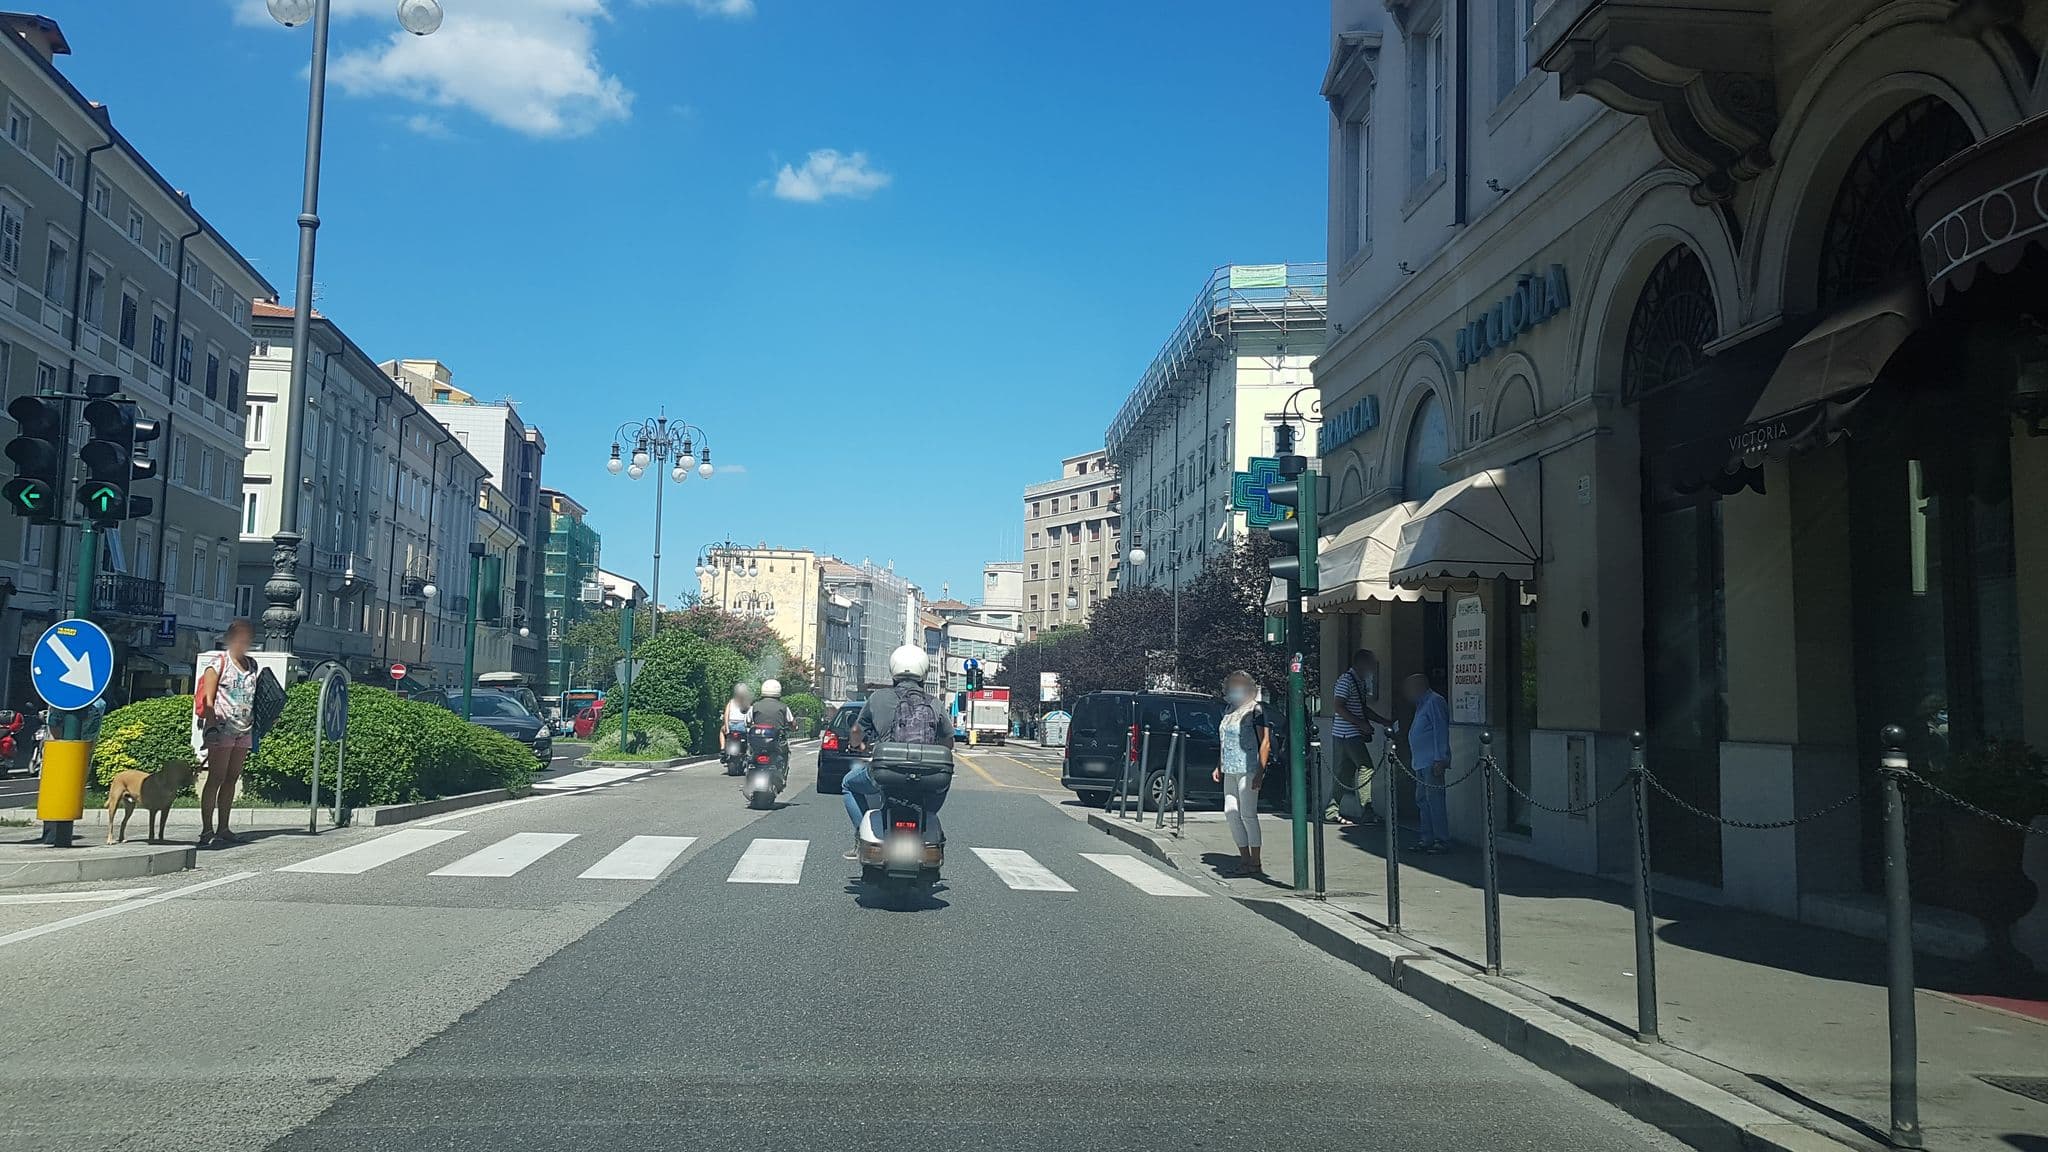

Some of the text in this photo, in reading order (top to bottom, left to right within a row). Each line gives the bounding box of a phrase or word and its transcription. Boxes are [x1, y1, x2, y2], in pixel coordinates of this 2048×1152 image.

[1456, 264, 1571, 371] PICCIOLA
[1729, 422, 1788, 451] VICTORIA
[1455, 640, 1483, 652] SEMPRE
[1455, 663, 1483, 674] SABATO E
[1455, 675, 1482, 685] DOMENICA
